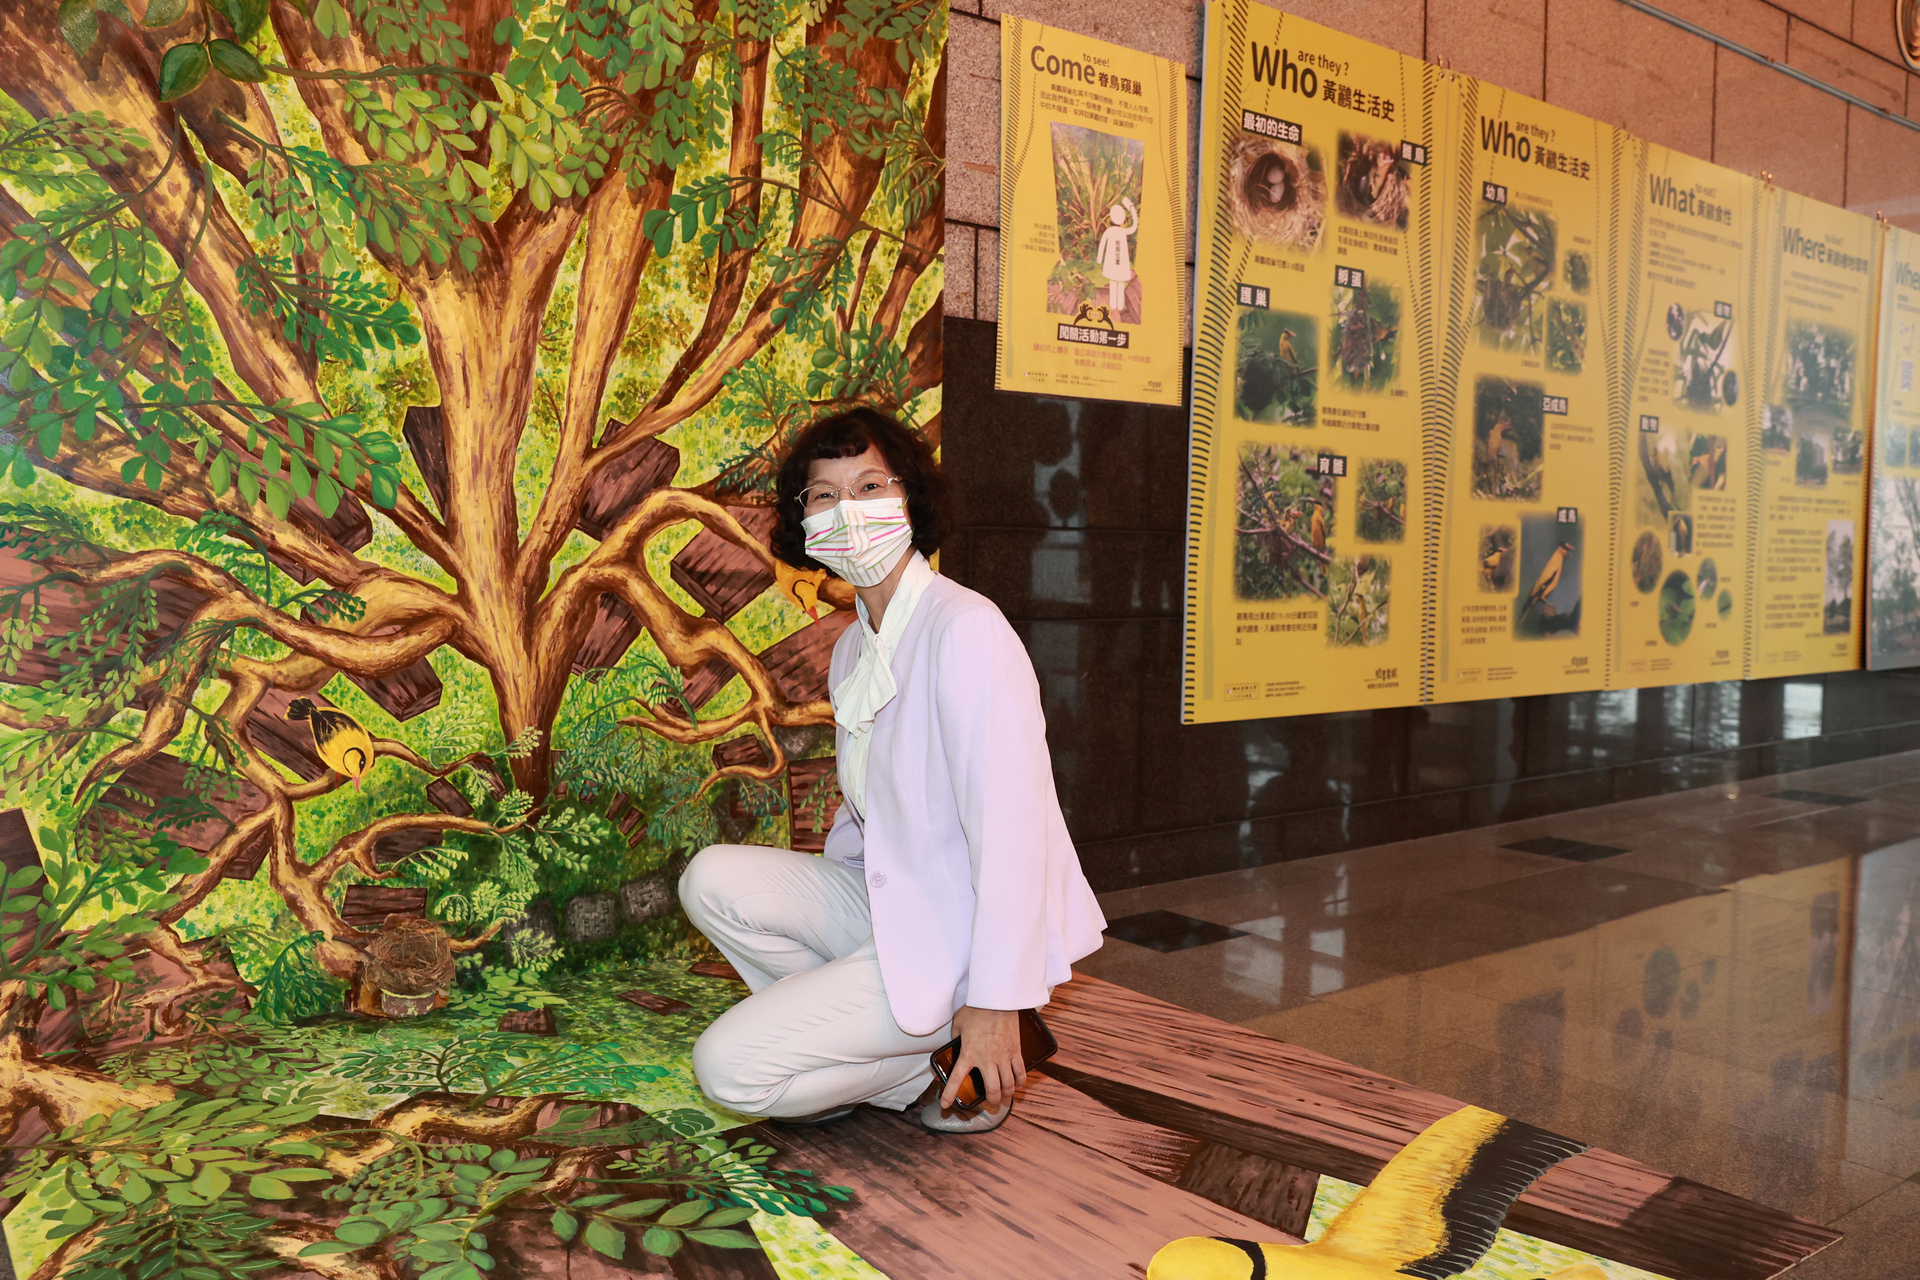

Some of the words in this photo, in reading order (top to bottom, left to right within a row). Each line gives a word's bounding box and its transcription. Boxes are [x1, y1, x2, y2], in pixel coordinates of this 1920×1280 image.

[1031, 45, 1096, 85] Come
[1083, 53, 1091, 63] to
[1093, 56, 1110, 68] see!
[1252, 41, 1317, 98] Who
[1298, 50, 1315, 65] are
[1318, 54, 1341, 77] they
[1323, 79, 1395, 123] 黃鸝生活史
[1243, 112, 1300, 142] 最初的生命
[1481, 115, 1531, 163] Who
[1515, 122, 1529, 134] are
[1531, 124, 1549, 143] they
[1534, 145, 1590, 181] 黃鸝生活史
[1650, 173, 1695, 216] What
[1783, 226, 1826, 263] Where
[1058, 325, 1127, 347] 闖關活動第一步
